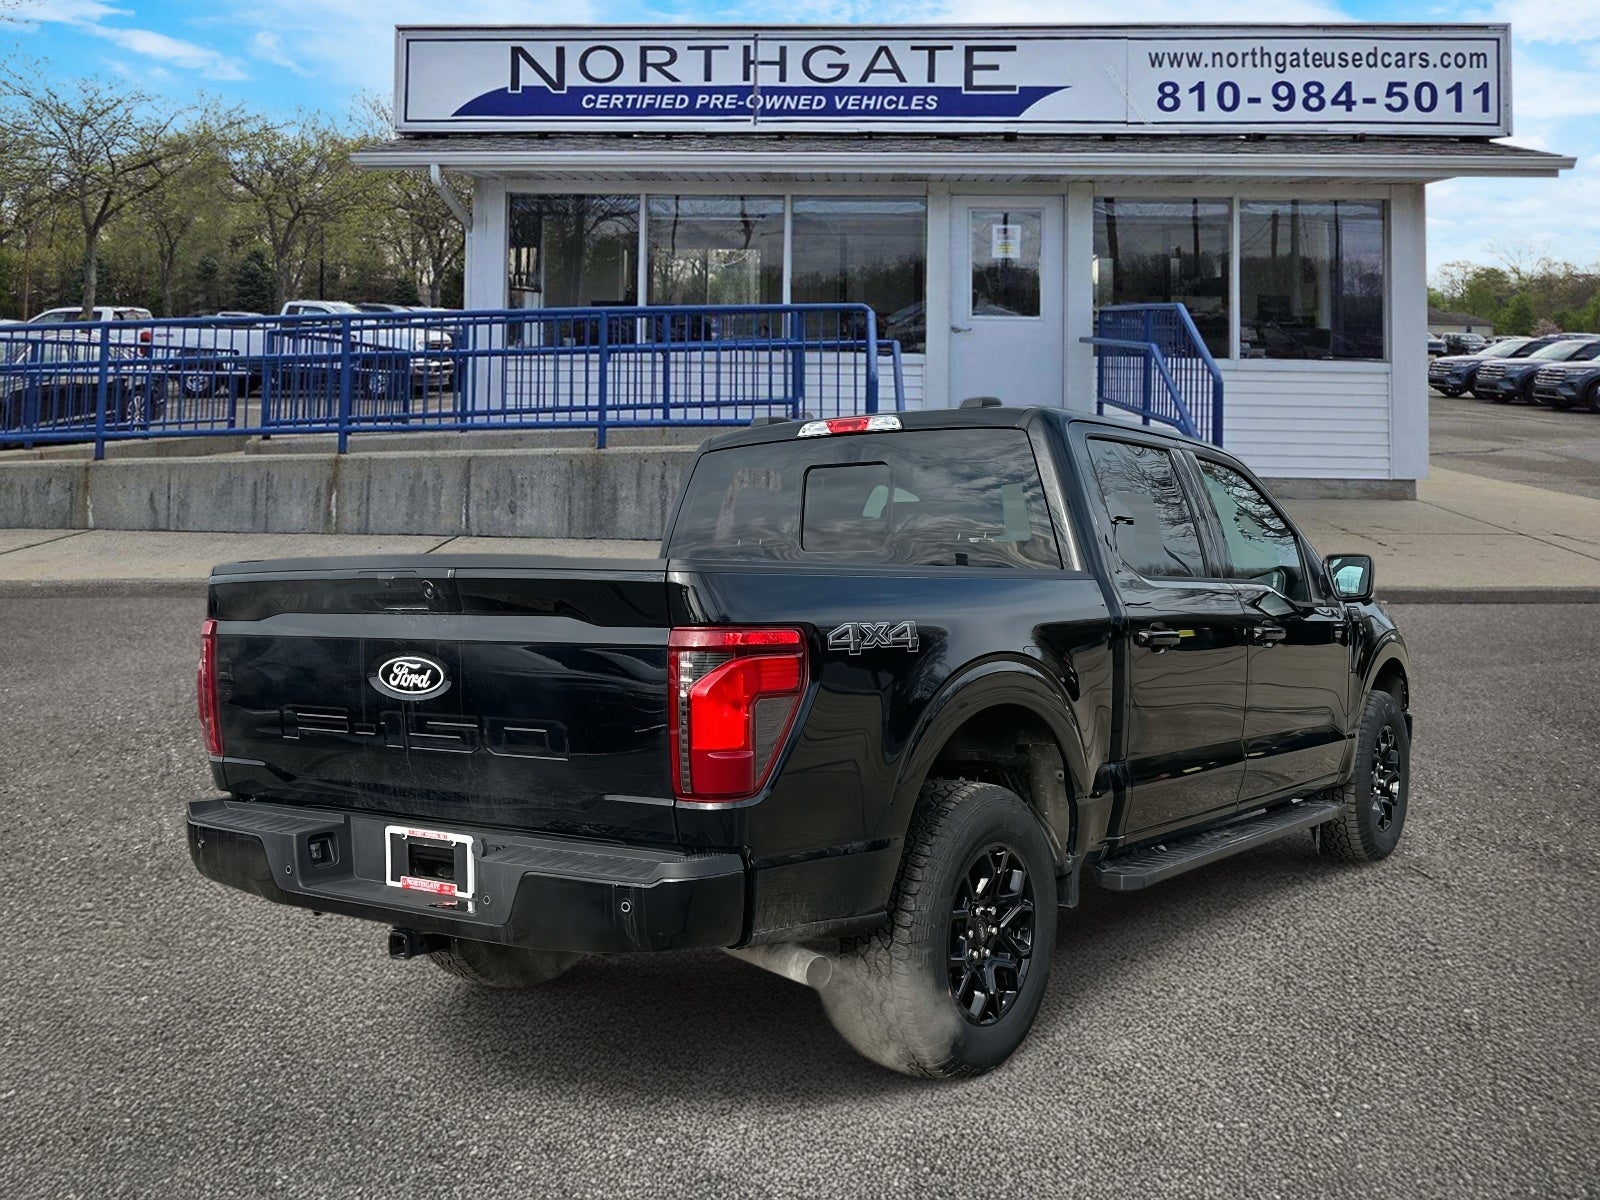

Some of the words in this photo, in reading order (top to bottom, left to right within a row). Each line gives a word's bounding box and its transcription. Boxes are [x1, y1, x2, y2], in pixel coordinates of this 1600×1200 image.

[510, 45, 1017, 92] NORTHGATE
[1148, 46, 1488, 73] www.northgateusedcars.com
[581, 94, 689, 109] CERTIFIED
[695, 94, 826, 110] PRE-OWNED
[834, 95, 938, 110] VEHICLES
[1156, 81, 1491, 113] 810-984-5011
[389, 661, 432, 688] Ford
